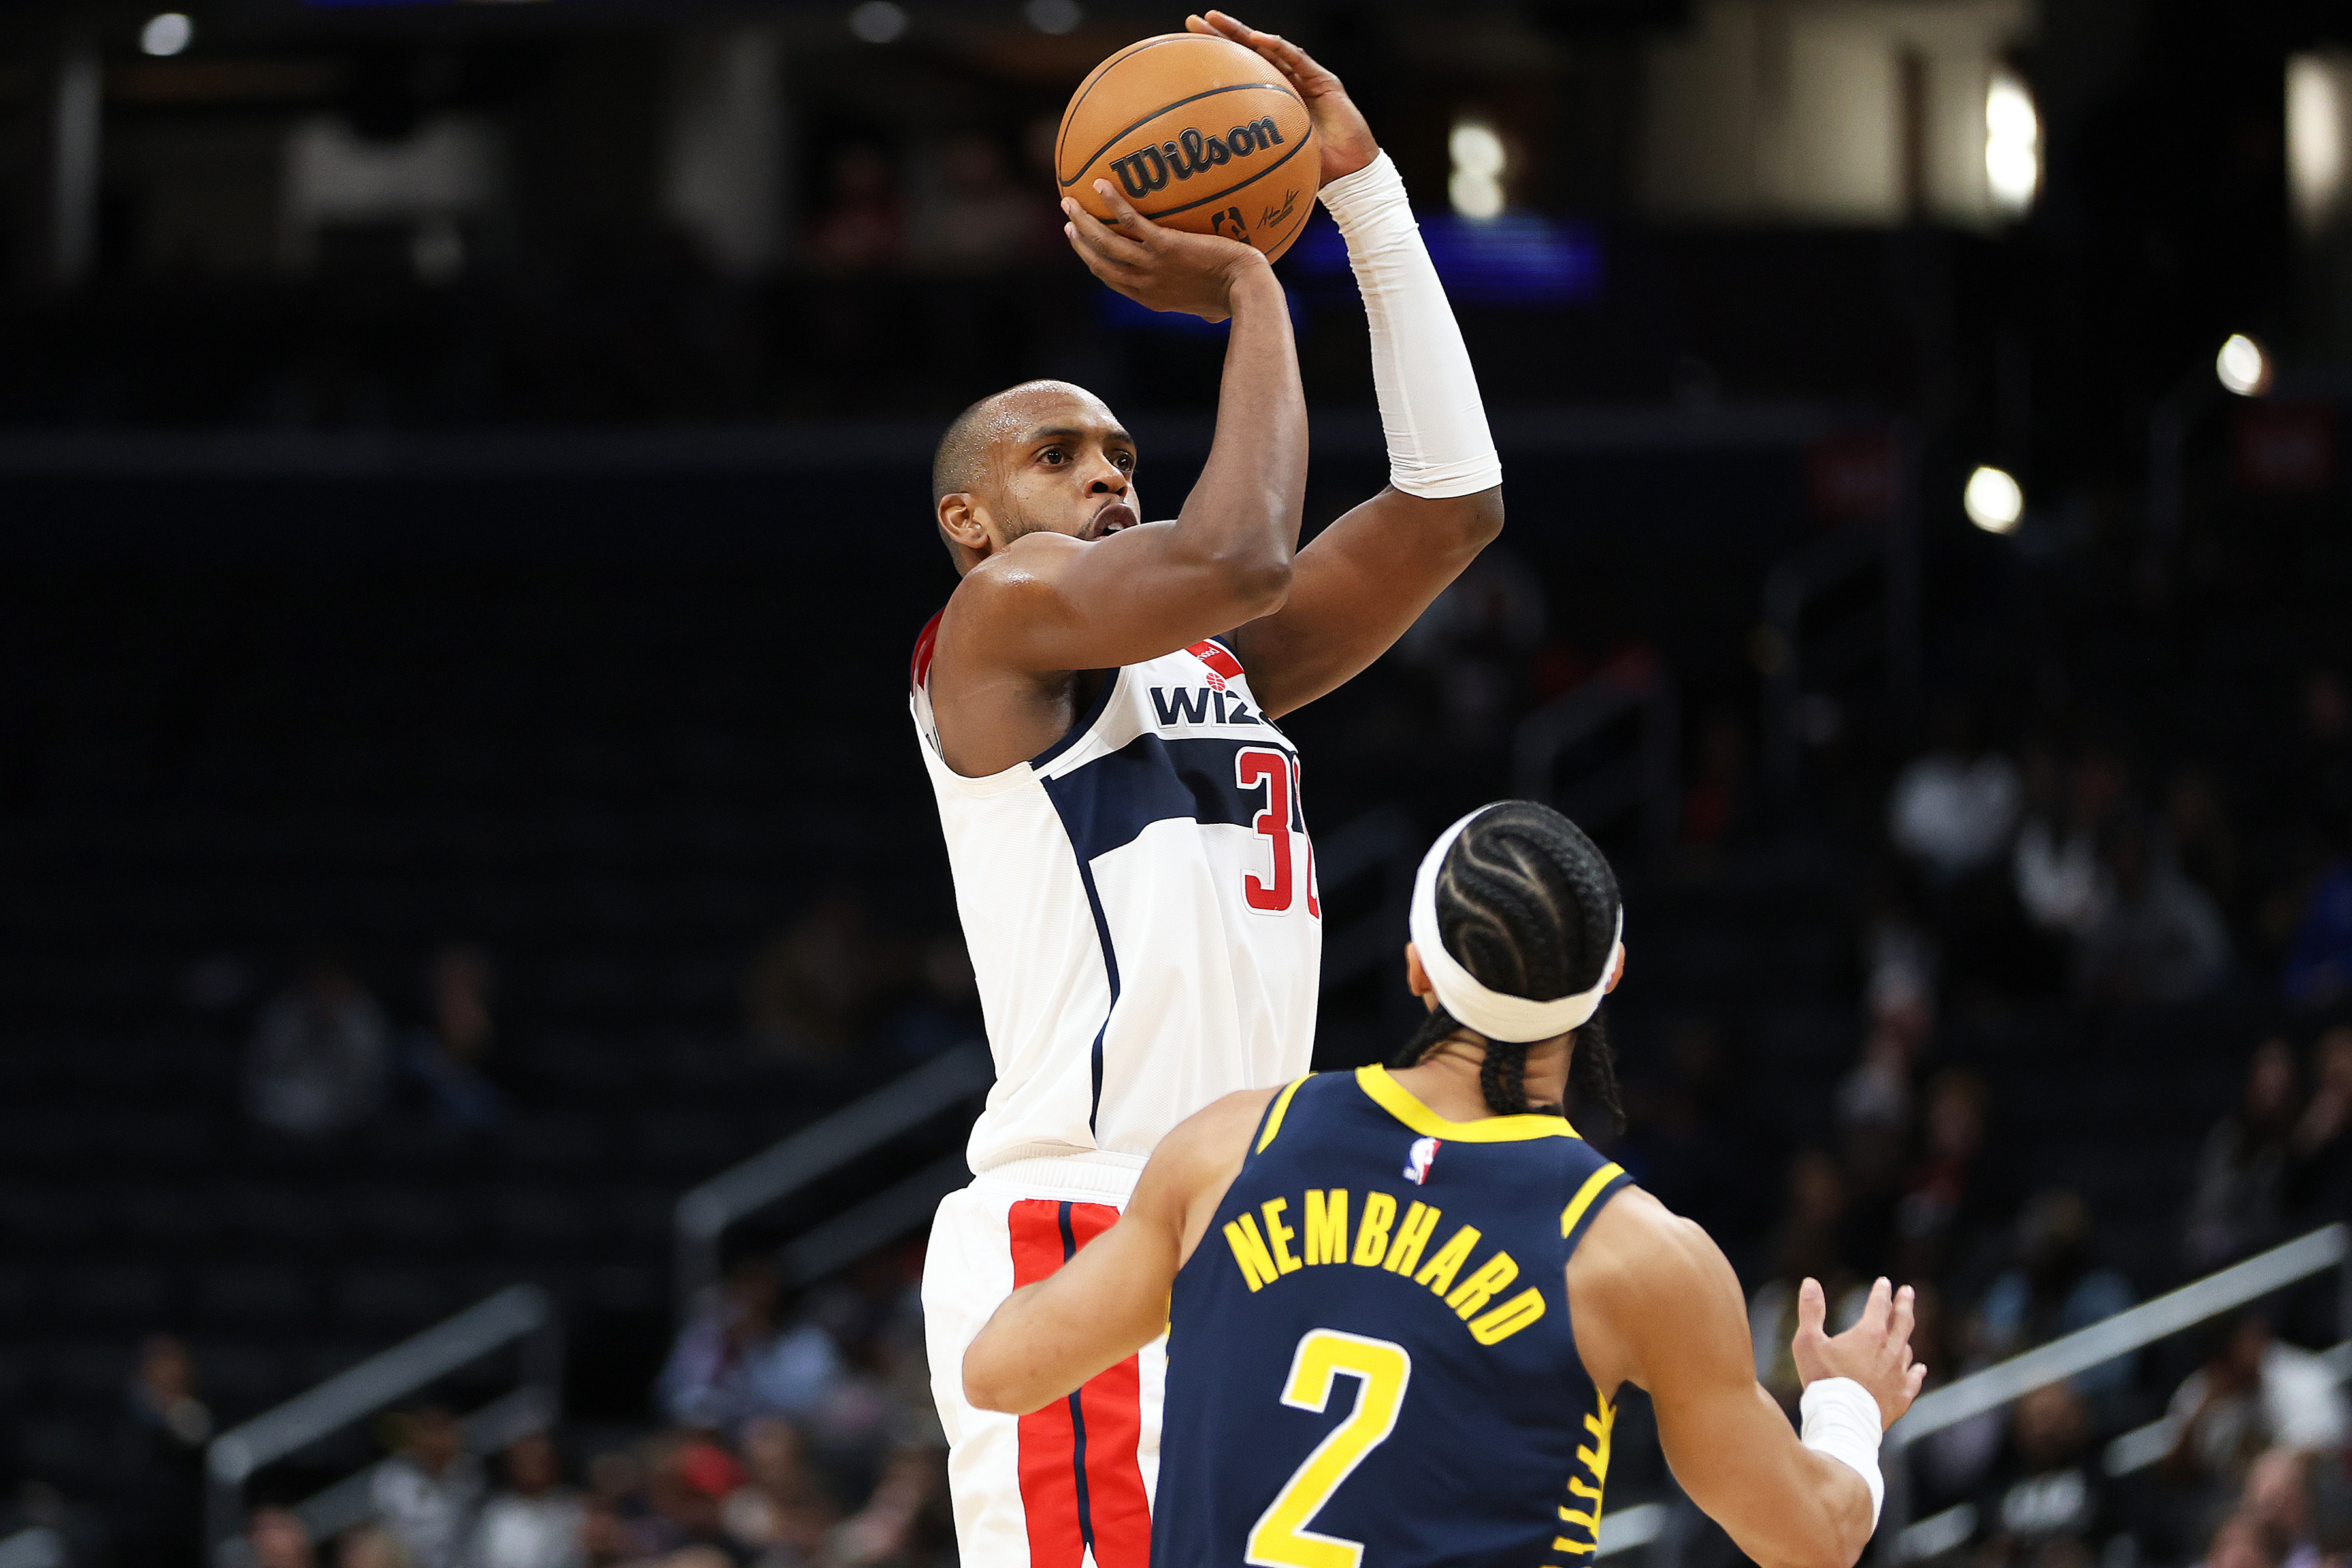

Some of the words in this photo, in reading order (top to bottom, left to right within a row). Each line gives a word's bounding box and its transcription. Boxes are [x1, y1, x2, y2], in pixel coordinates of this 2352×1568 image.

[1110, 116, 1285, 199] Wilson
[1235, 746, 1321, 924] 3
[1222, 1188, 1546, 1346] NEMBHARD
[1244, 1328, 1411, 1568] 2
